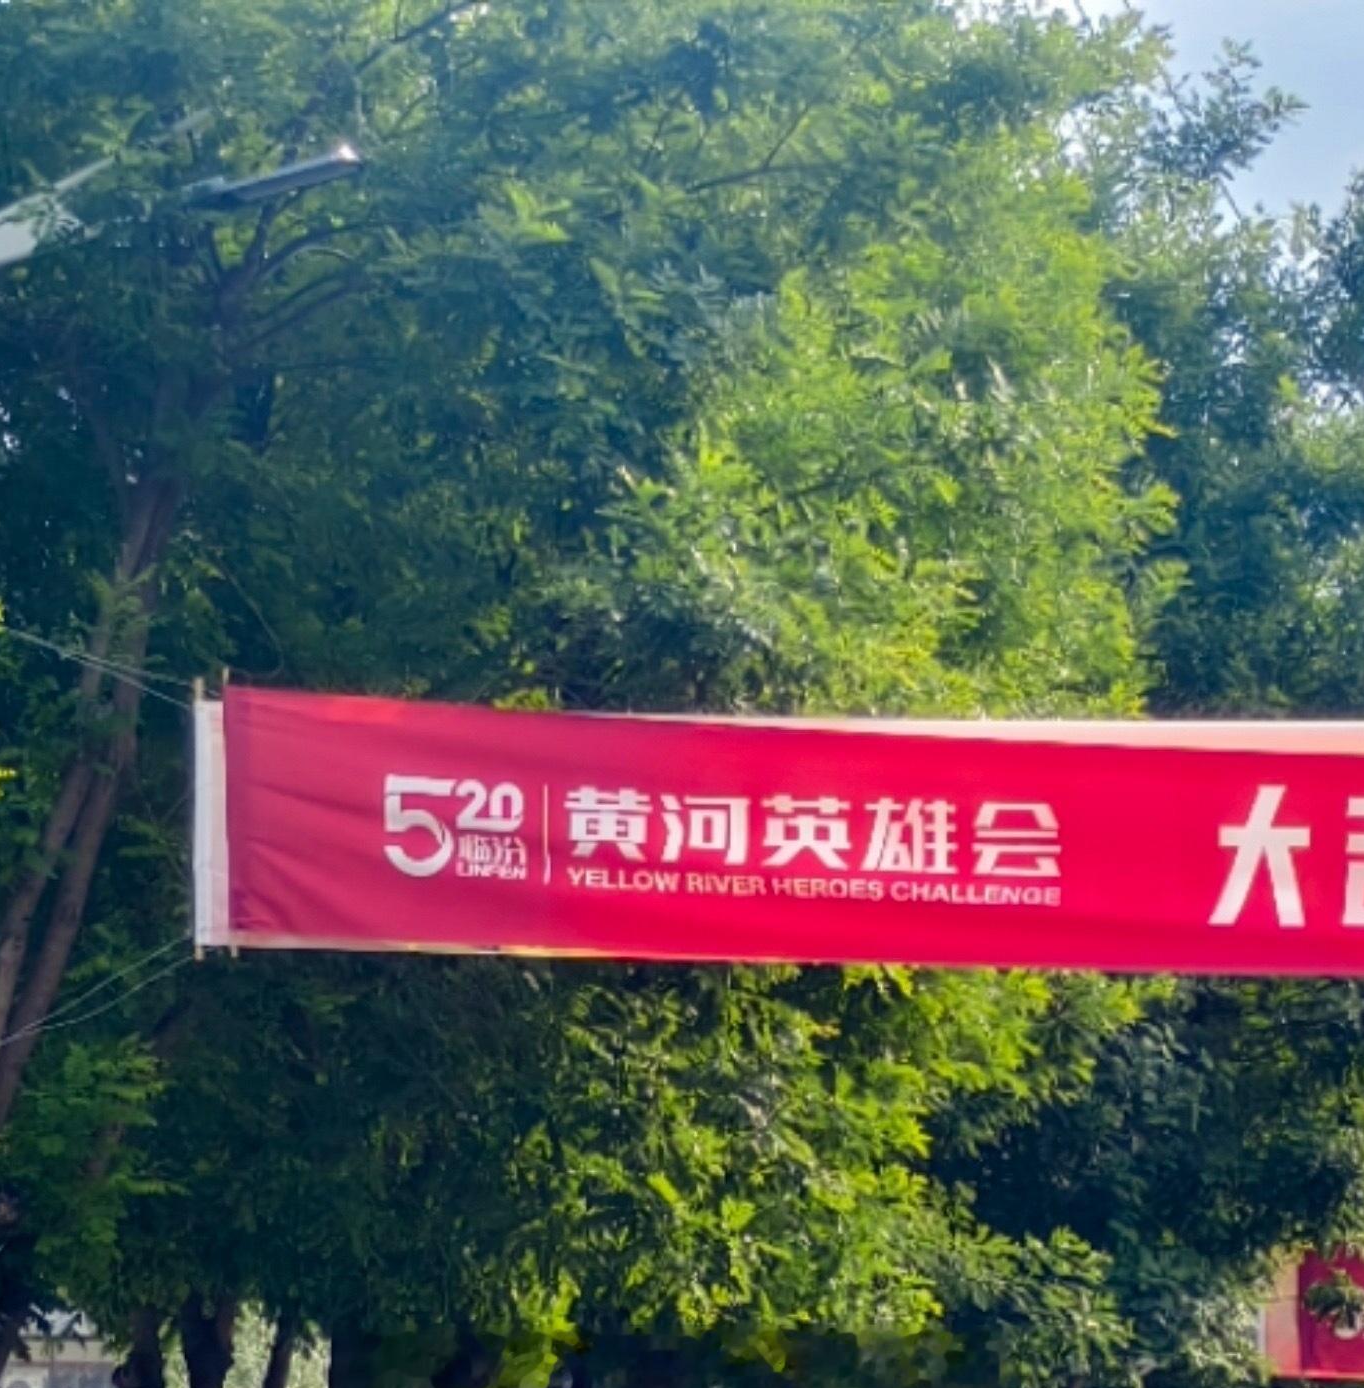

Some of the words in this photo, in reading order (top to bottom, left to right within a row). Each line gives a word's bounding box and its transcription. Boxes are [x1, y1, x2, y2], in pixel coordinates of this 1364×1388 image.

[565, 784, 1062, 879] 黄河英雄会
[567, 867, 679, 895] YELLOW
[687, 872, 768, 898] RIVER
[771, 876, 884, 902] HEROES
[889, 881, 1062, 908] CHALLENGE
